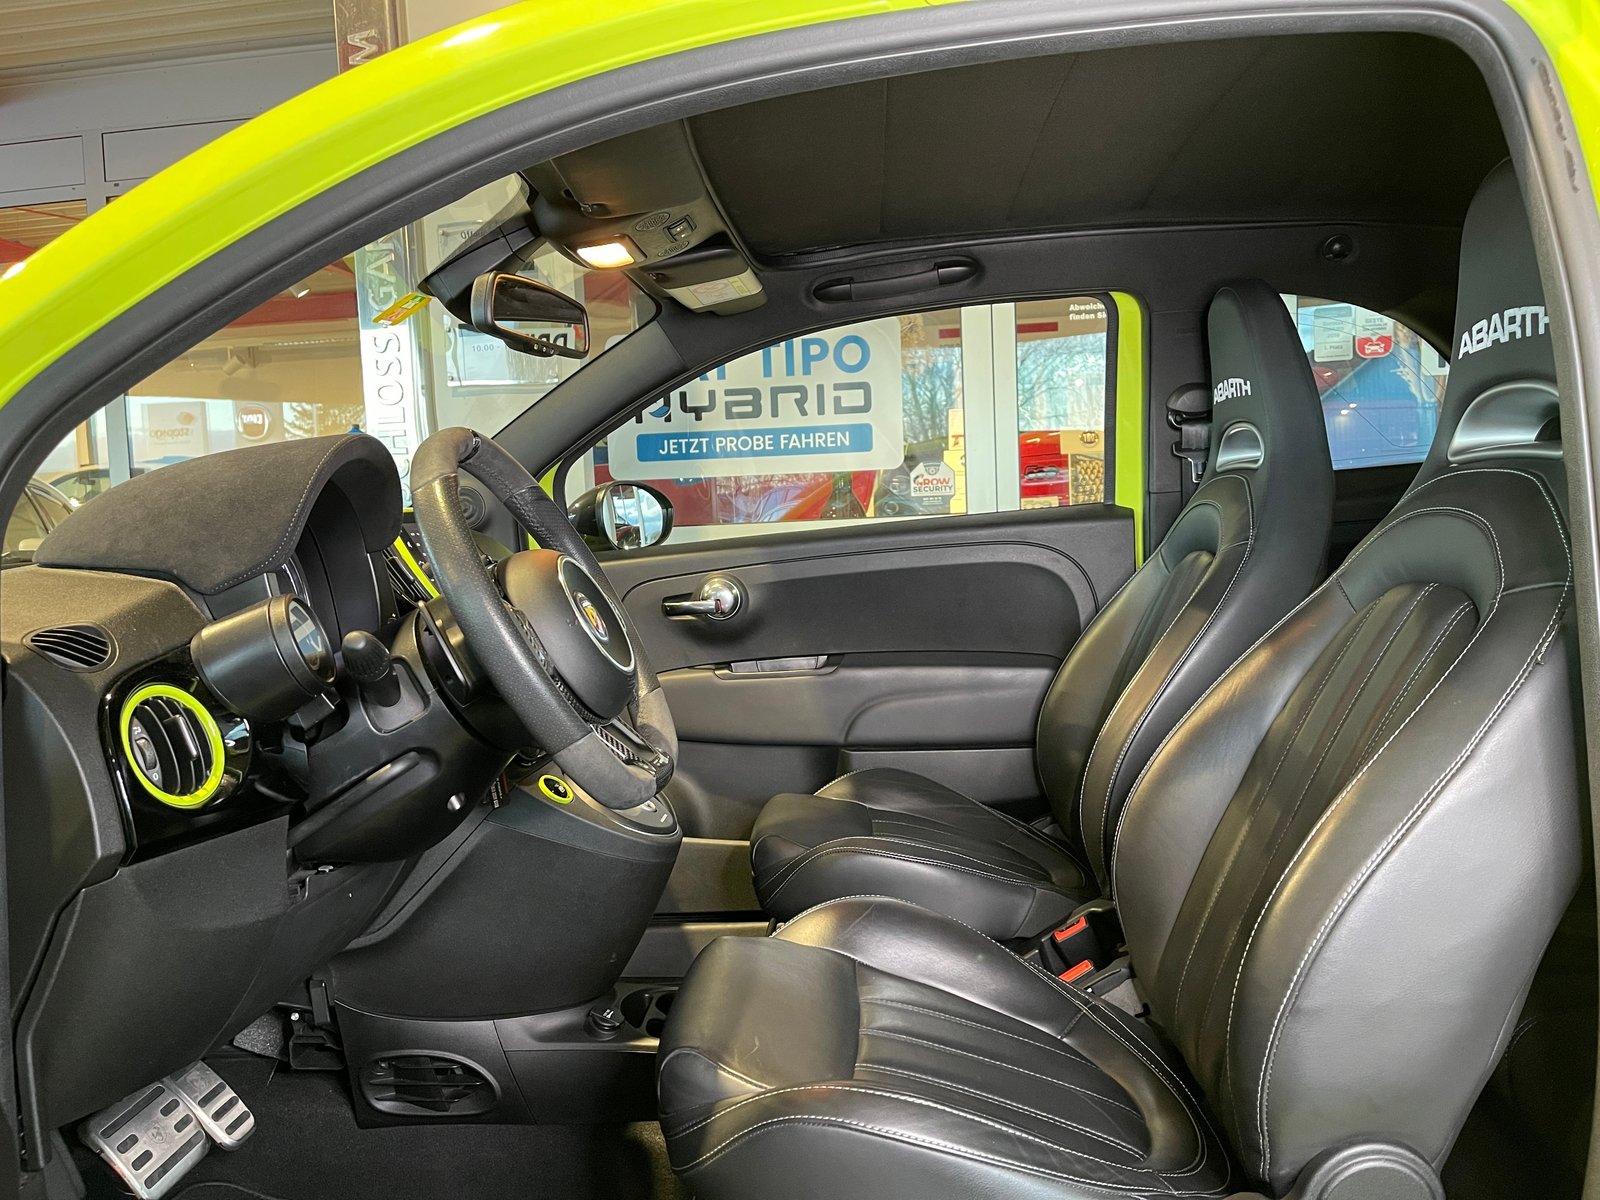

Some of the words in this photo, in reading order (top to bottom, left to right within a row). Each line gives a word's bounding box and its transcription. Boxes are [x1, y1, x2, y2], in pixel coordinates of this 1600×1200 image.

[1213, 378, 1251, 405] ABARTH
[659, 438, 709, 454] JETZT
[715, 434, 773, 452] PROBE
[780, 431, 849, 449] FAHREN
[913, 485, 953, 493] SECURITY
